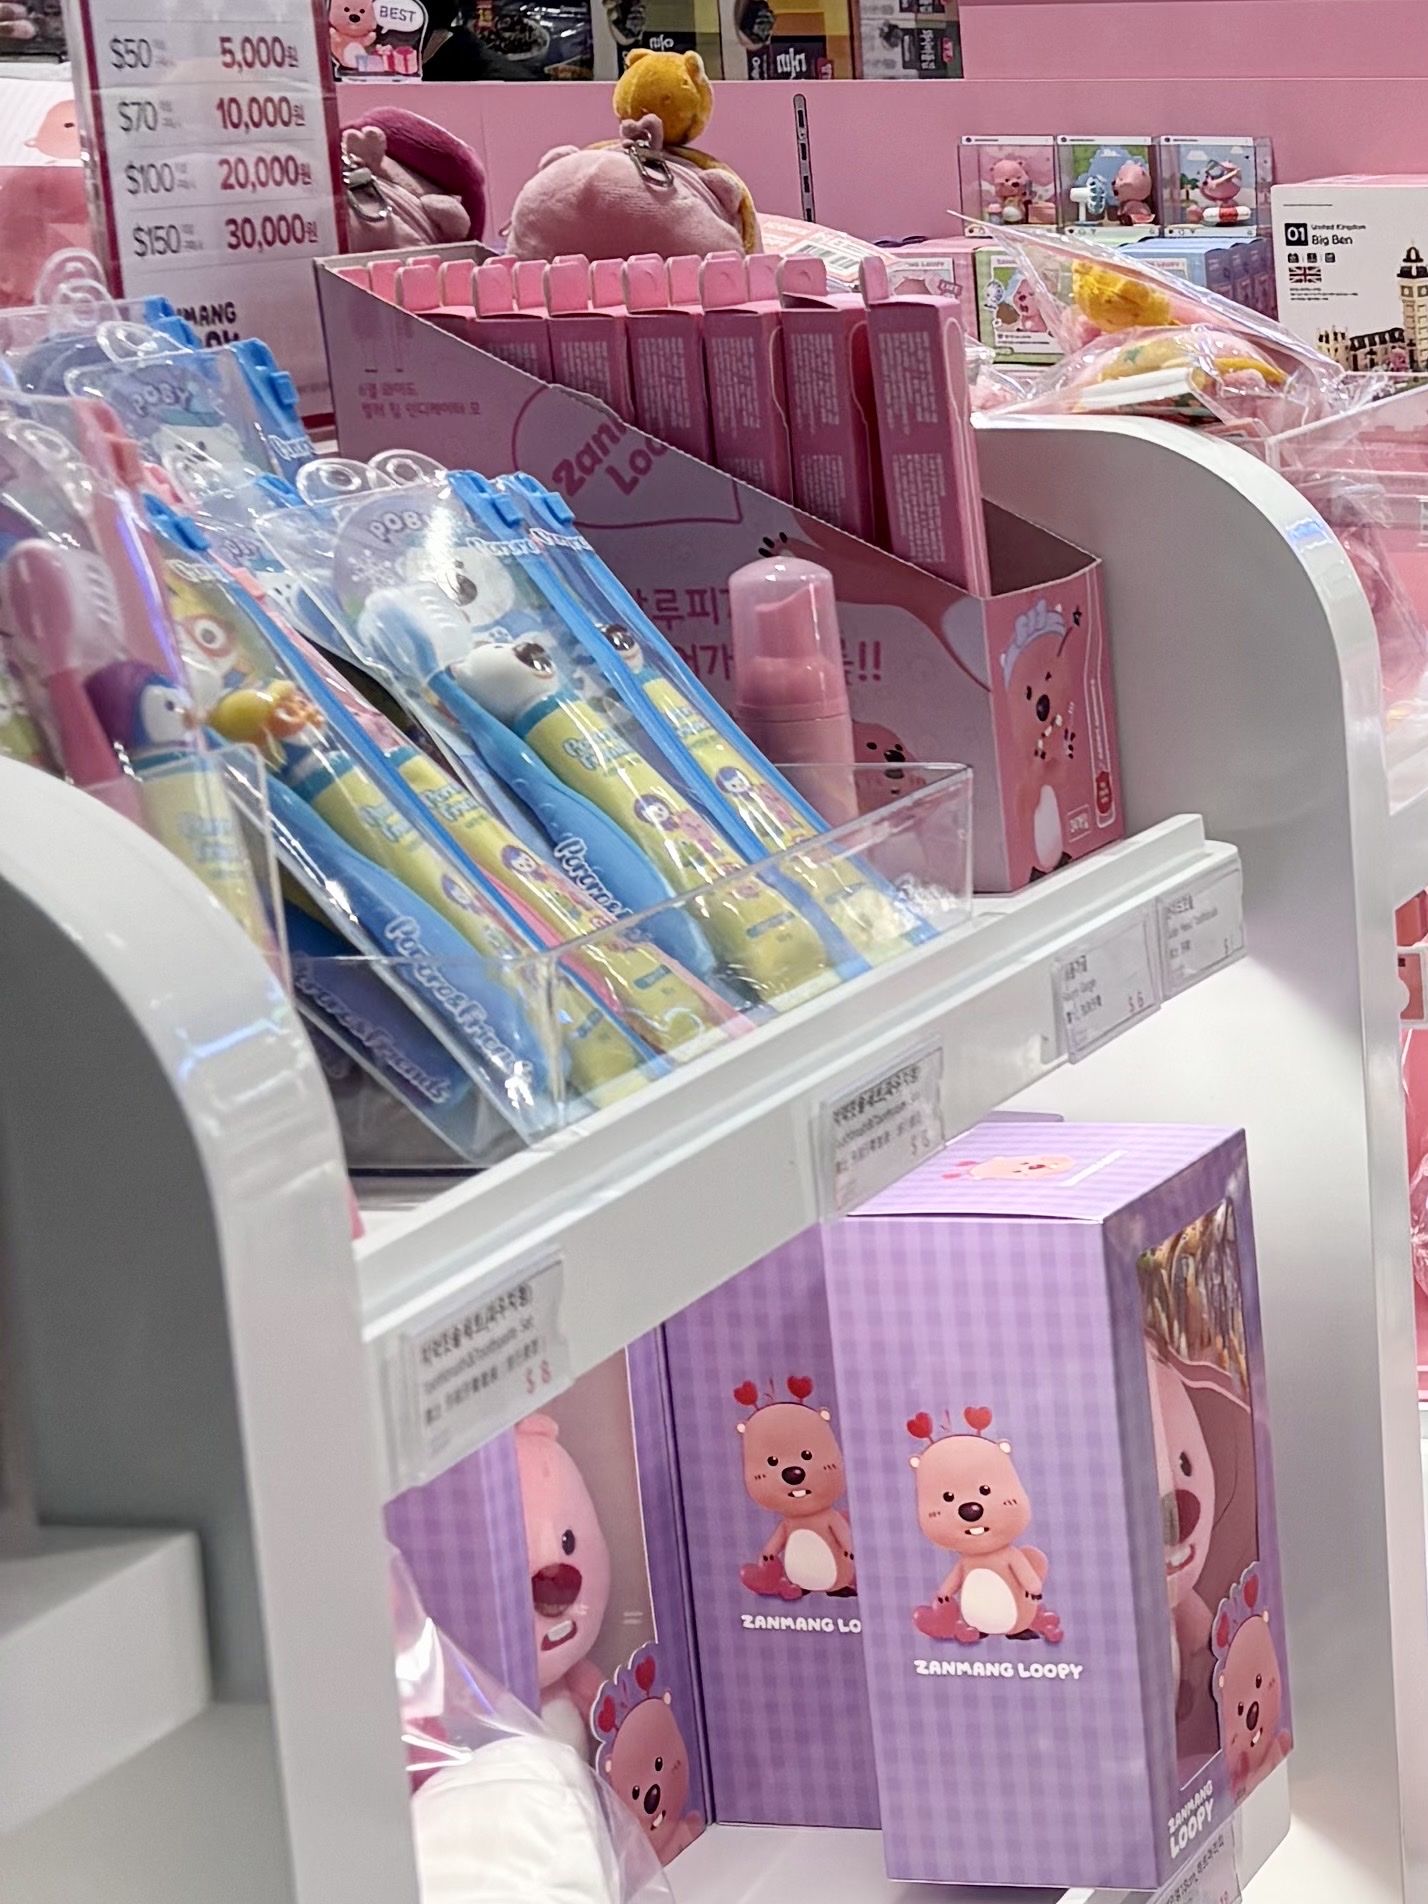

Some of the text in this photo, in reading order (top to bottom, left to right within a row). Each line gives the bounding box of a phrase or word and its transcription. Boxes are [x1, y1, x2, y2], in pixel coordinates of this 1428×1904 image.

[378, 4, 418, 25] BEST
[109, 34, 300, 73] $50 5,000원
[117, 96, 306, 135] $70 10,000원
[125, 154, 313, 196] $100 20,000원
[132, 212, 319, 258] $150 30,000원
[1285, 225, 1307, 243] 01
[1310, 234, 1353, 247] Big Ben
[524, 1368, 537, 1396] $
[742, 1613, 835, 1633] ZANMANG
[913, 1658, 1084, 1682] ZANMANG LOOPY
[1166, 1779, 1215, 1834] ZANMANG
[1169, 1796, 1218, 1860] LOOPY
